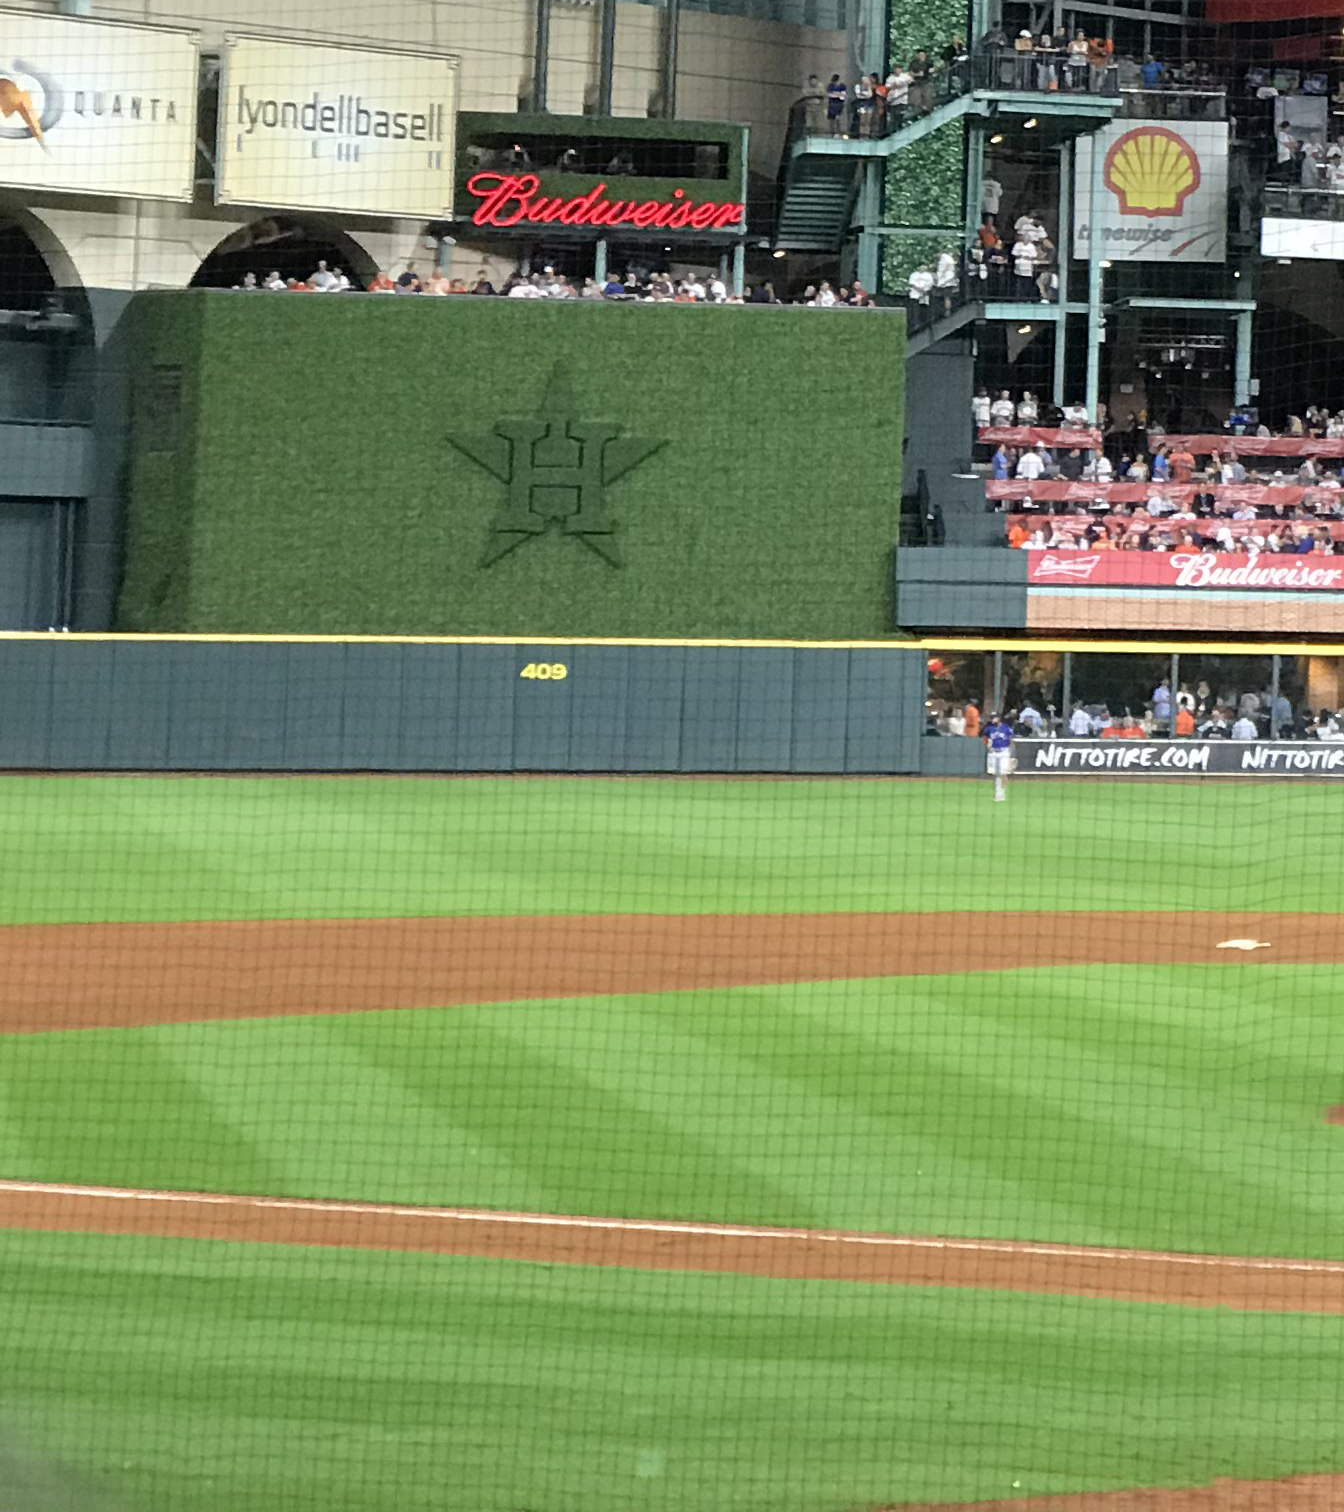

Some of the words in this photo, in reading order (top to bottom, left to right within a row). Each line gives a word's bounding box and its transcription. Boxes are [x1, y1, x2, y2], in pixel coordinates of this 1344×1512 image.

[73, 91, 177, 122] QUANTA
[237, 84, 443, 141] lyondellbasell
[467, 172, 745, 231] Budweiser
[1170, 553, 1343, 587] Budweiser
[521, 662, 568, 681] 409
[1035, 744, 1210, 770] NITTOTIRE.COM
